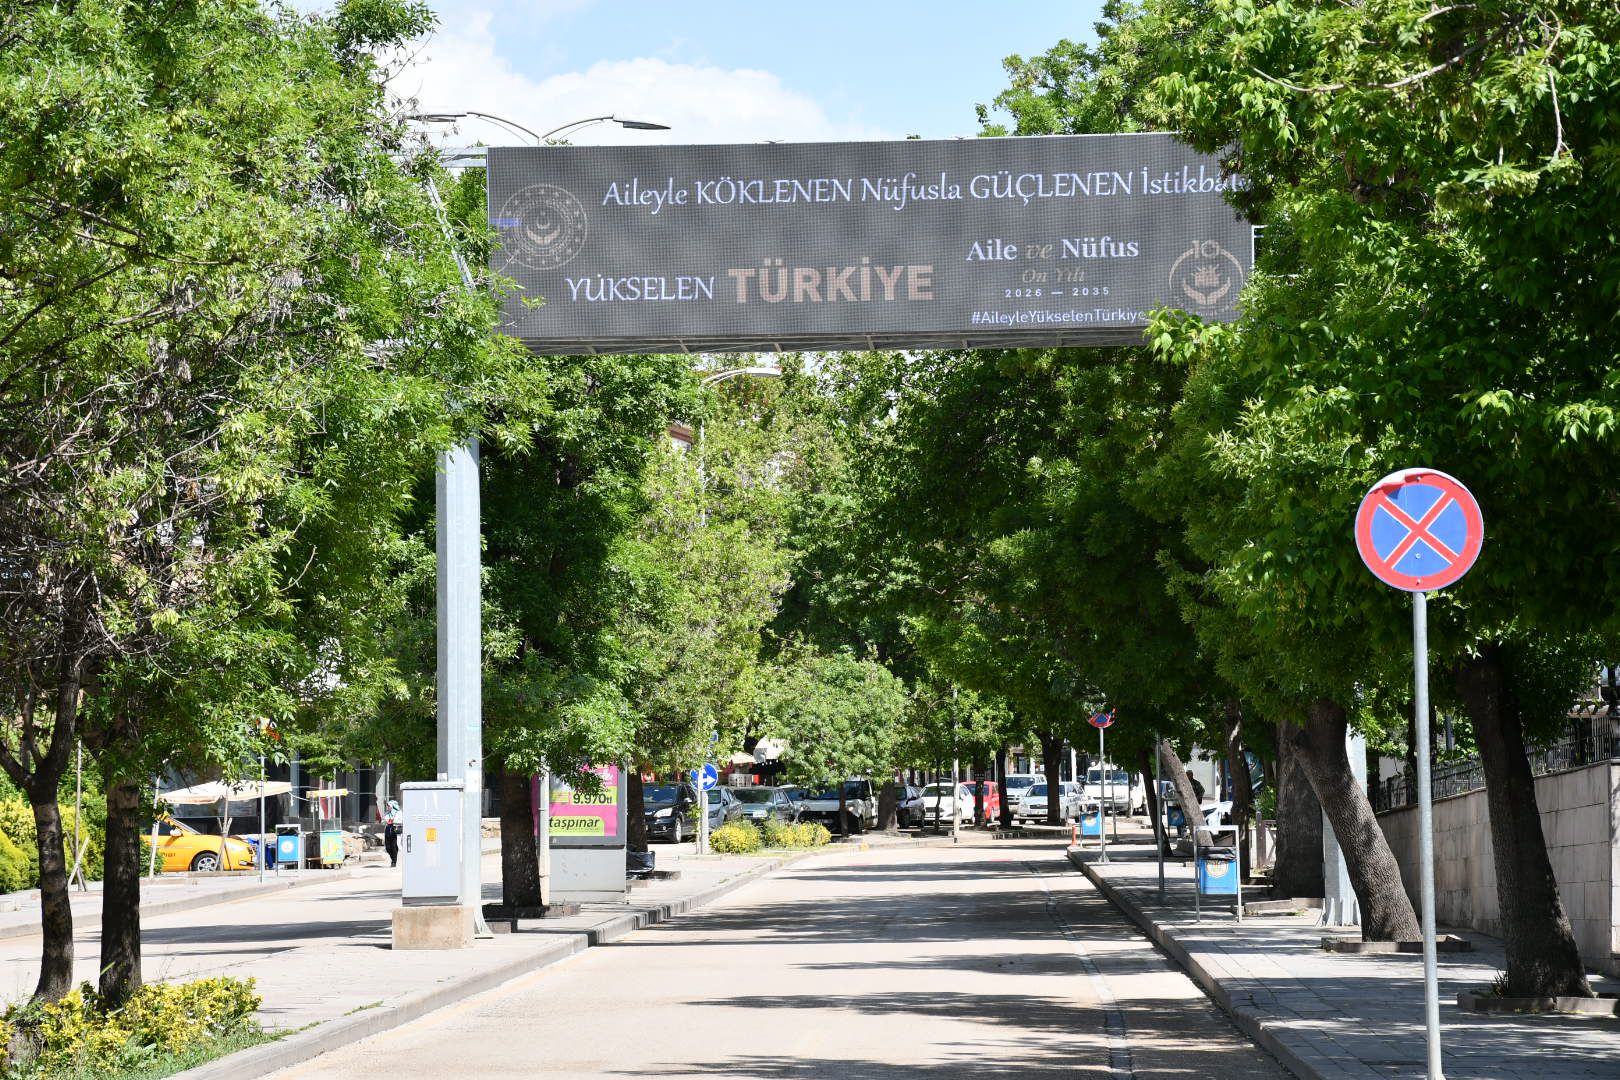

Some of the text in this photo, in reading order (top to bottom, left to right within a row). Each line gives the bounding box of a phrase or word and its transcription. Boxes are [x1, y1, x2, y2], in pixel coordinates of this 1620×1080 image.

[602, 177, 688, 215] Aileyle
[695, 176, 853, 204] KÖKLENEN
[861, 172, 963, 211] Nüfusla
[970, 170, 1133, 207] GÜÇLENEN
[966, 236, 1139, 261] Aile ve Nüfus
[564, 256, 934, 304] YÜKSELEN TÜRKİYE
[1022, 268, 1048, 283] On
[1004, 288, 1042, 298] 2026
[1072, 286, 1110, 297] 2035
